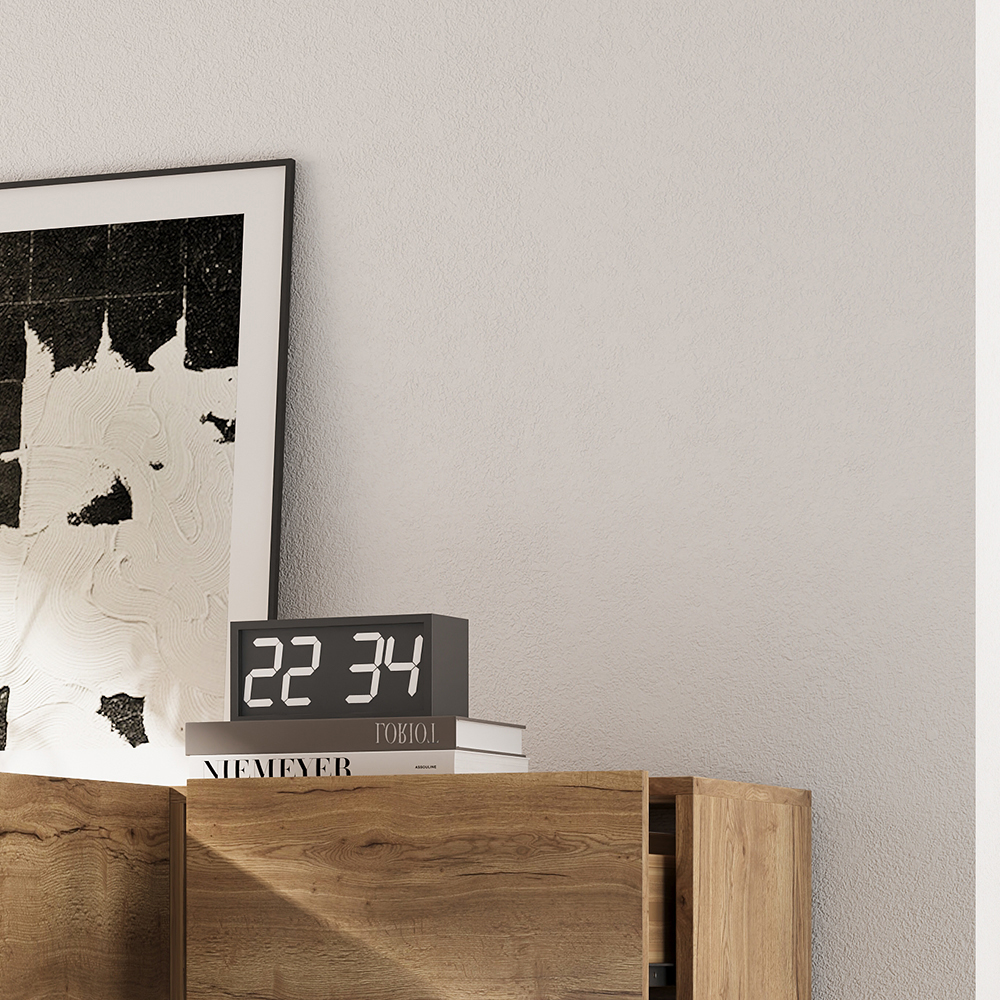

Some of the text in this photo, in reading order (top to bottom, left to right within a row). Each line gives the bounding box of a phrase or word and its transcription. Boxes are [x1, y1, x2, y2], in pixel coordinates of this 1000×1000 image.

[243, 631, 424, 708] 22 34
[203, 757, 352, 778] NIEMEYER
